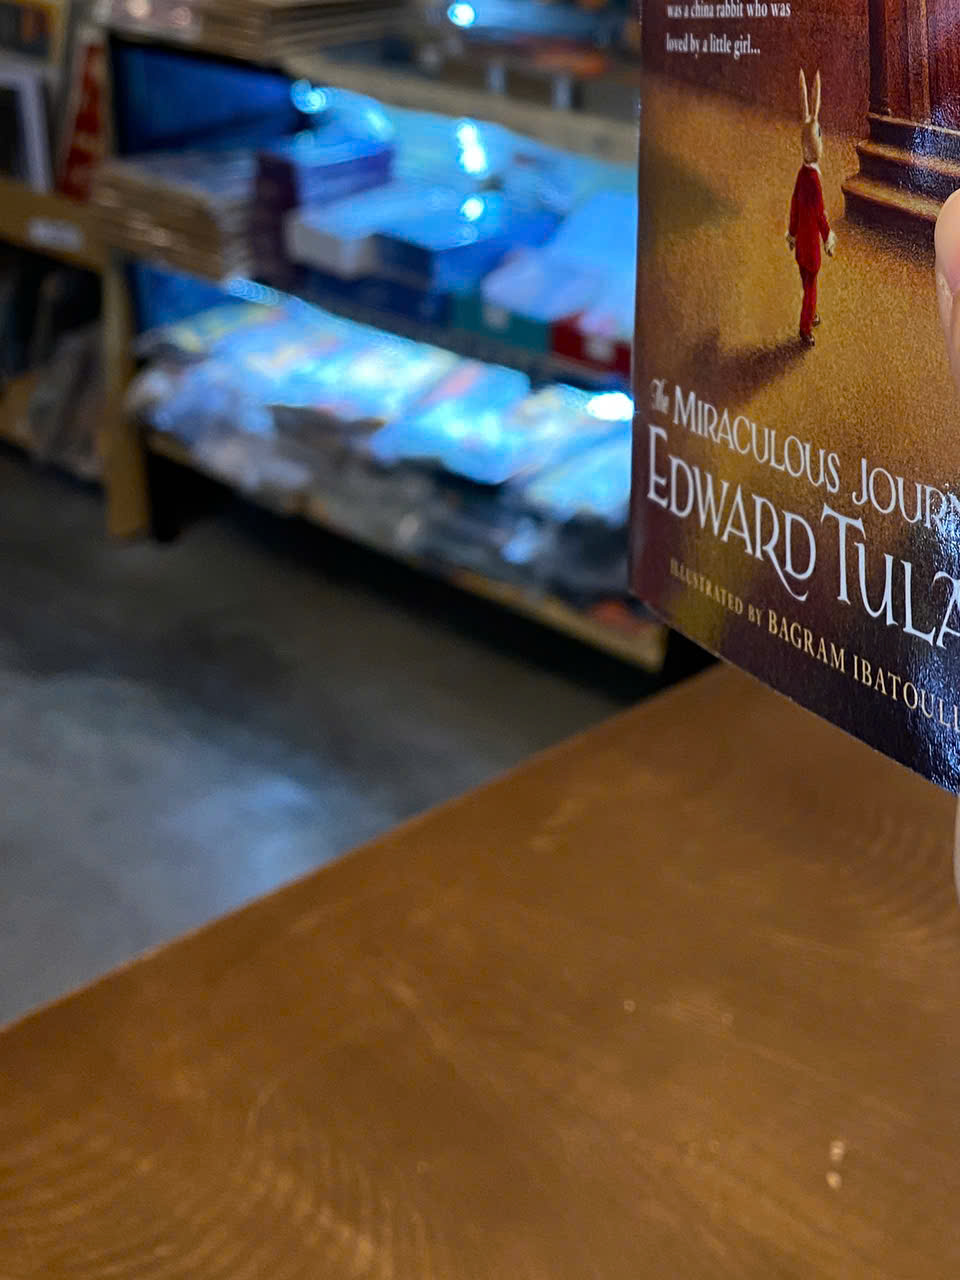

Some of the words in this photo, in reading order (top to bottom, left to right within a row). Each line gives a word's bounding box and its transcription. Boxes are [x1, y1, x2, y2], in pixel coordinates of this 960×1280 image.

[666, 32, 688, 53] loved
[690, 32, 700, 60] by
[702, 39, 707, 53] a
[710, 32, 732, 54] little
[733, 33, 761, 61] girl...
[667, 4, 682, 18] was
[684, 4, 689, 18] a
[690, 0, 714, 18] china
[770, 2, 791, 17] was
[672, 385, 841, 494] MIRACULOUS
[646, 423, 818, 602] EDWARD
[669, 557, 744, 615] ILLUSTRATED
[747, 603, 763, 627] BY
[767, 609, 847, 674] BAGRAM
